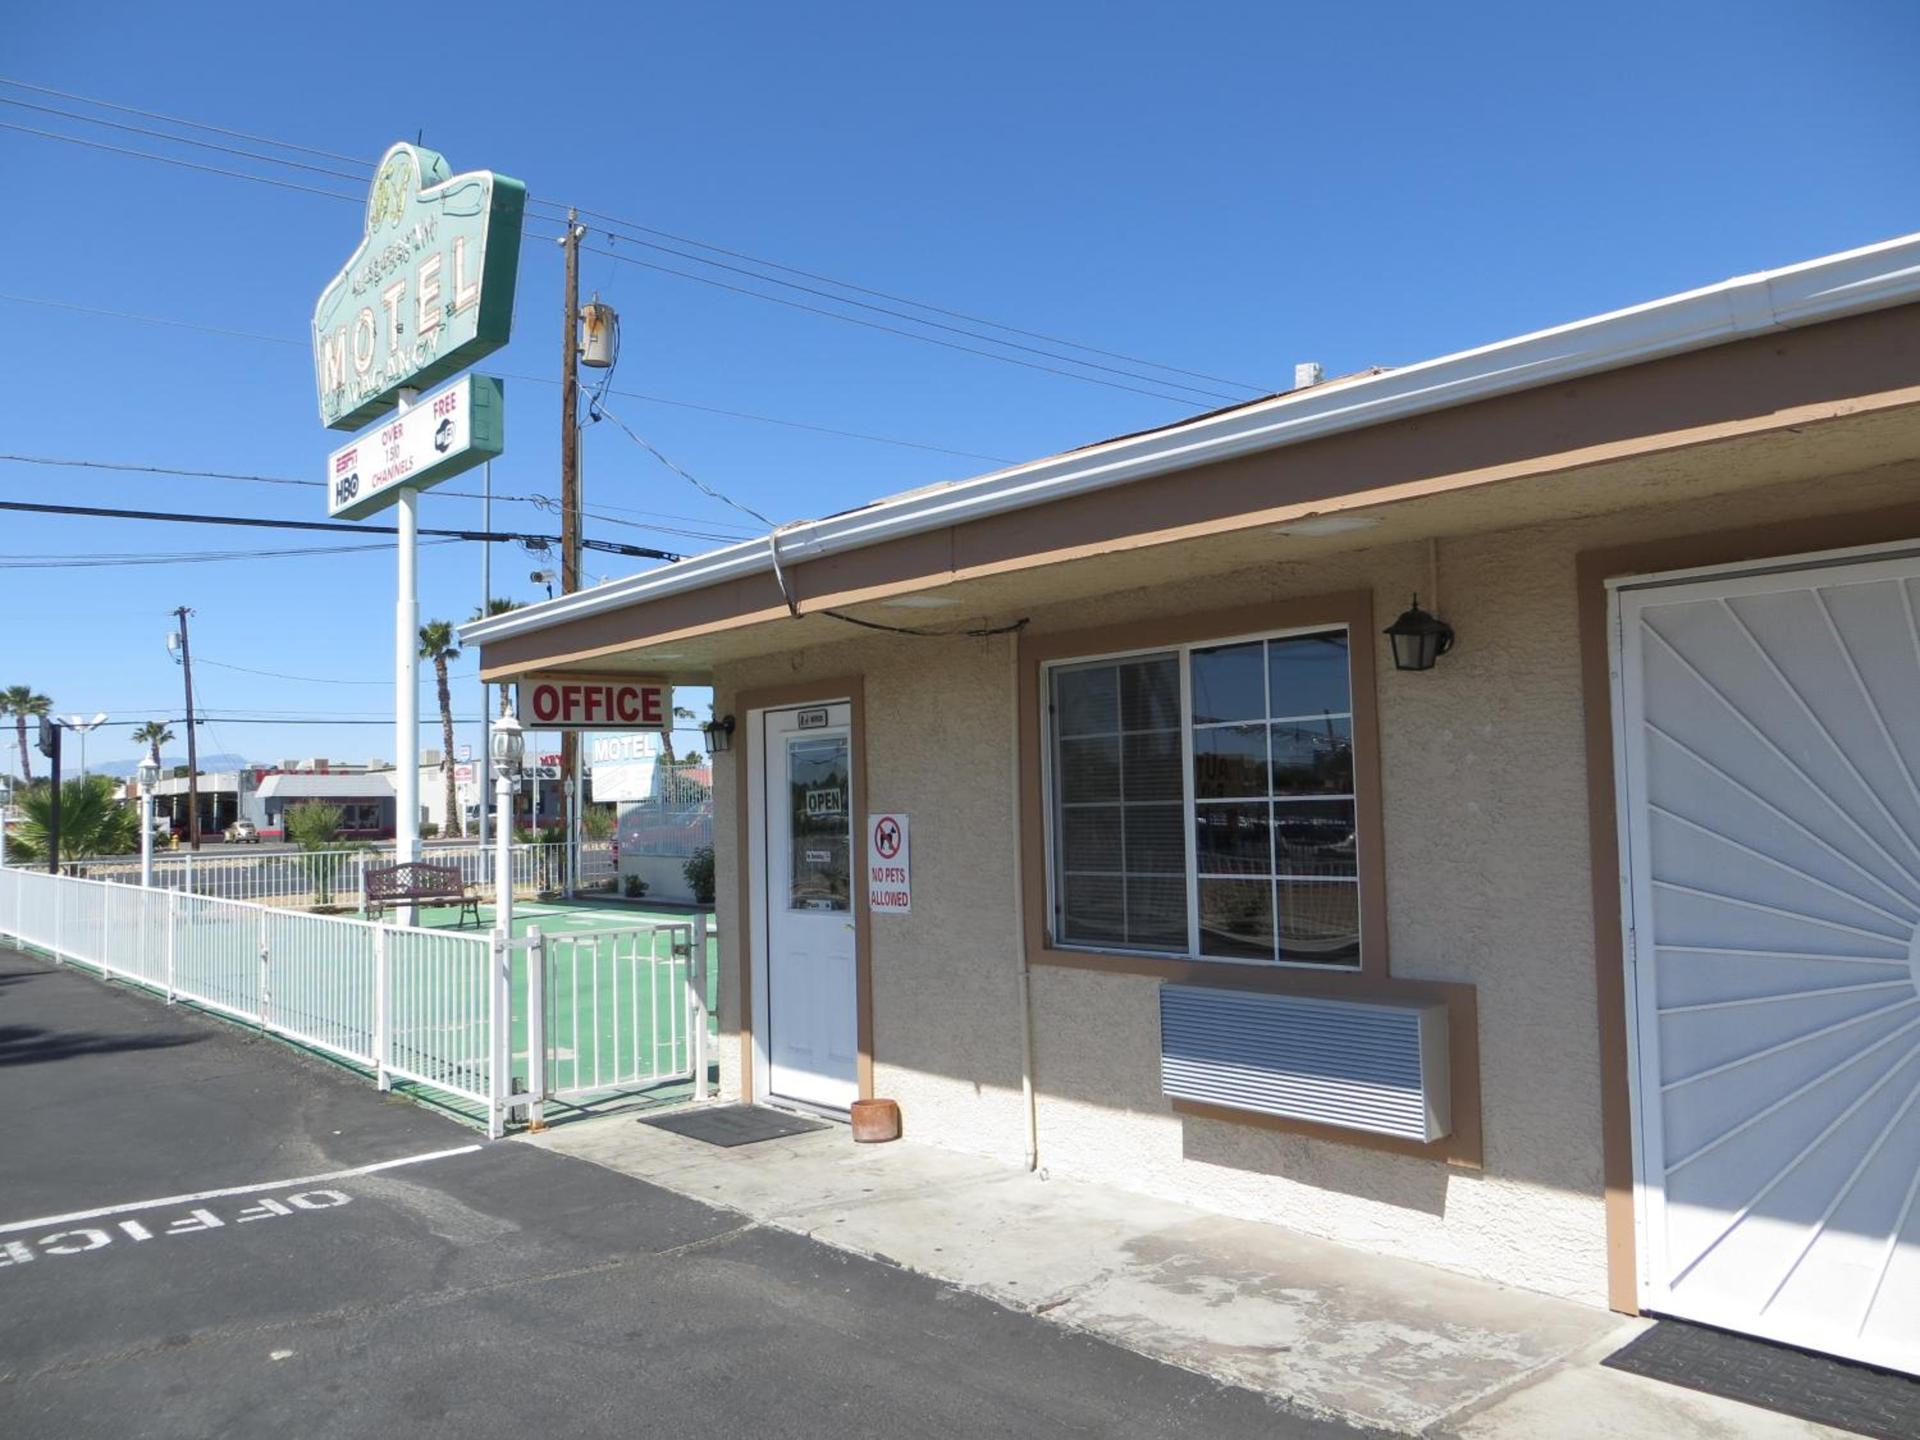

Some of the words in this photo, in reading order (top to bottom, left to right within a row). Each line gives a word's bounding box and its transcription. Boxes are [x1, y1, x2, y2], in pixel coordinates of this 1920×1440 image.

[320, 234, 480, 393] MOTEL
[433, 391, 457, 420] FREE
[381, 422, 404, 446] OVER
[371, 455, 414, 489] CHANNELS
[335, 472, 360, 507] HBO
[532, 684, 663, 722] OFFICE
[594, 735, 657, 762] MOTEL
[808, 790, 841, 814] OPEN
[872, 868, 885, 882] NO
[886, 867, 905, 883] PETS
[871, 891, 909, 908] ALLOWED
